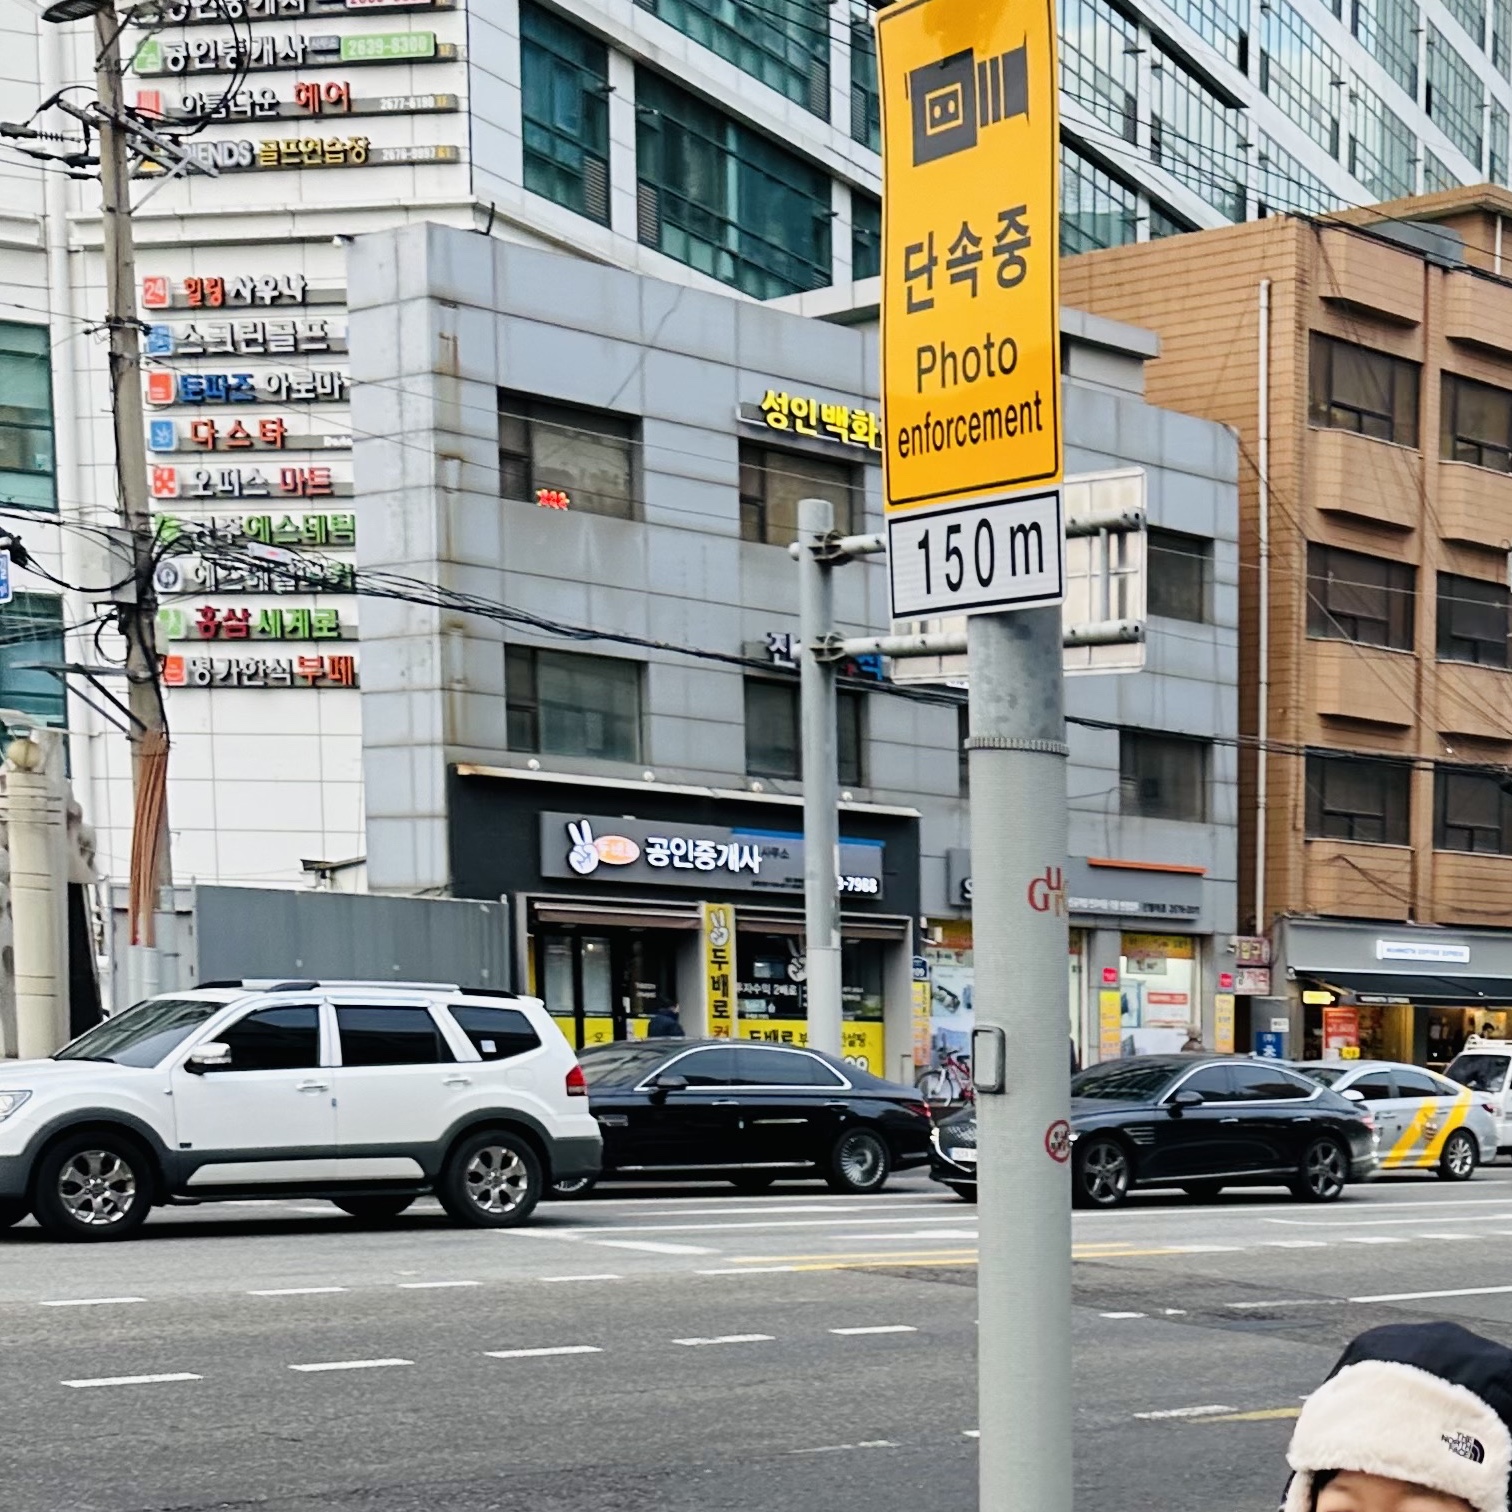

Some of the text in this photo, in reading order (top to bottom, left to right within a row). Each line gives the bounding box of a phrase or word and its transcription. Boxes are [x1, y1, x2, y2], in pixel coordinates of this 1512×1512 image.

[163, 35, 306, 72] 공인중개사
[294, 81, 350, 114] 헤어
[258, 136, 370, 165] 골프연습장
[903, 204, 1032, 315] 단속중
[230, 273, 307, 304] 사우나
[177, 319, 328, 354] 스크린골프
[916, 333, 1018, 394] Photo
[265, 370, 347, 399] 아로마
[760, 389, 882, 449] 성인백화
[898, 397, 1043, 459] enforcement
[190, 466, 334, 496] 오피스 마트
[195, 605, 341, 639] 홍삼 세계로
[191, 654, 357, 687] 명가한식 부페
[645, 836, 763, 875] 공인중개사
[710, 948, 732, 1020] 두배로
[1441, 1434, 1473, 1452] NORTH
[1448, 1442, 1474, 1461] FACE
[1456, 1431, 1475, 1446] THE
